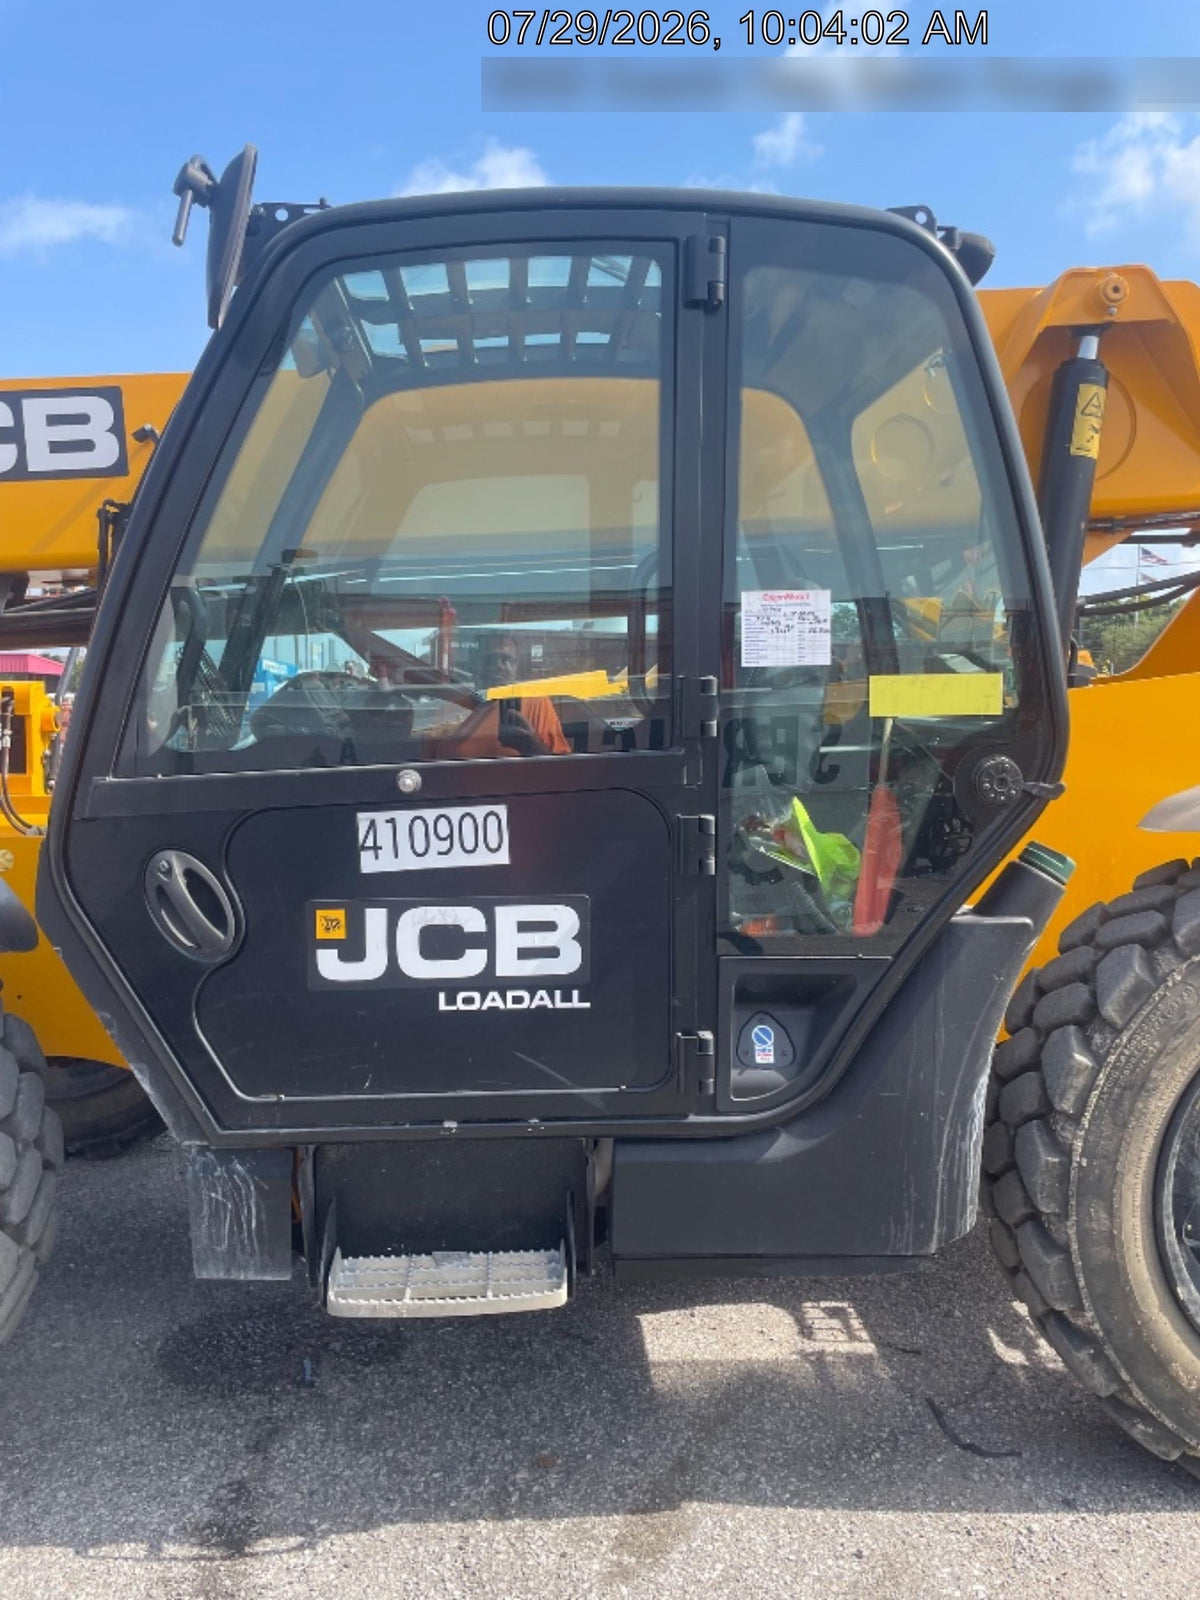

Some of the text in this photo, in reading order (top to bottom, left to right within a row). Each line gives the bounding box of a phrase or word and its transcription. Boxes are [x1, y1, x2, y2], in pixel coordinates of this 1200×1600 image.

[0, 396, 120, 473] B
[359, 810, 504, 861] 410900
[315, 904, 582, 982] JCB
[438, 989, 591, 1011] LOADALL
